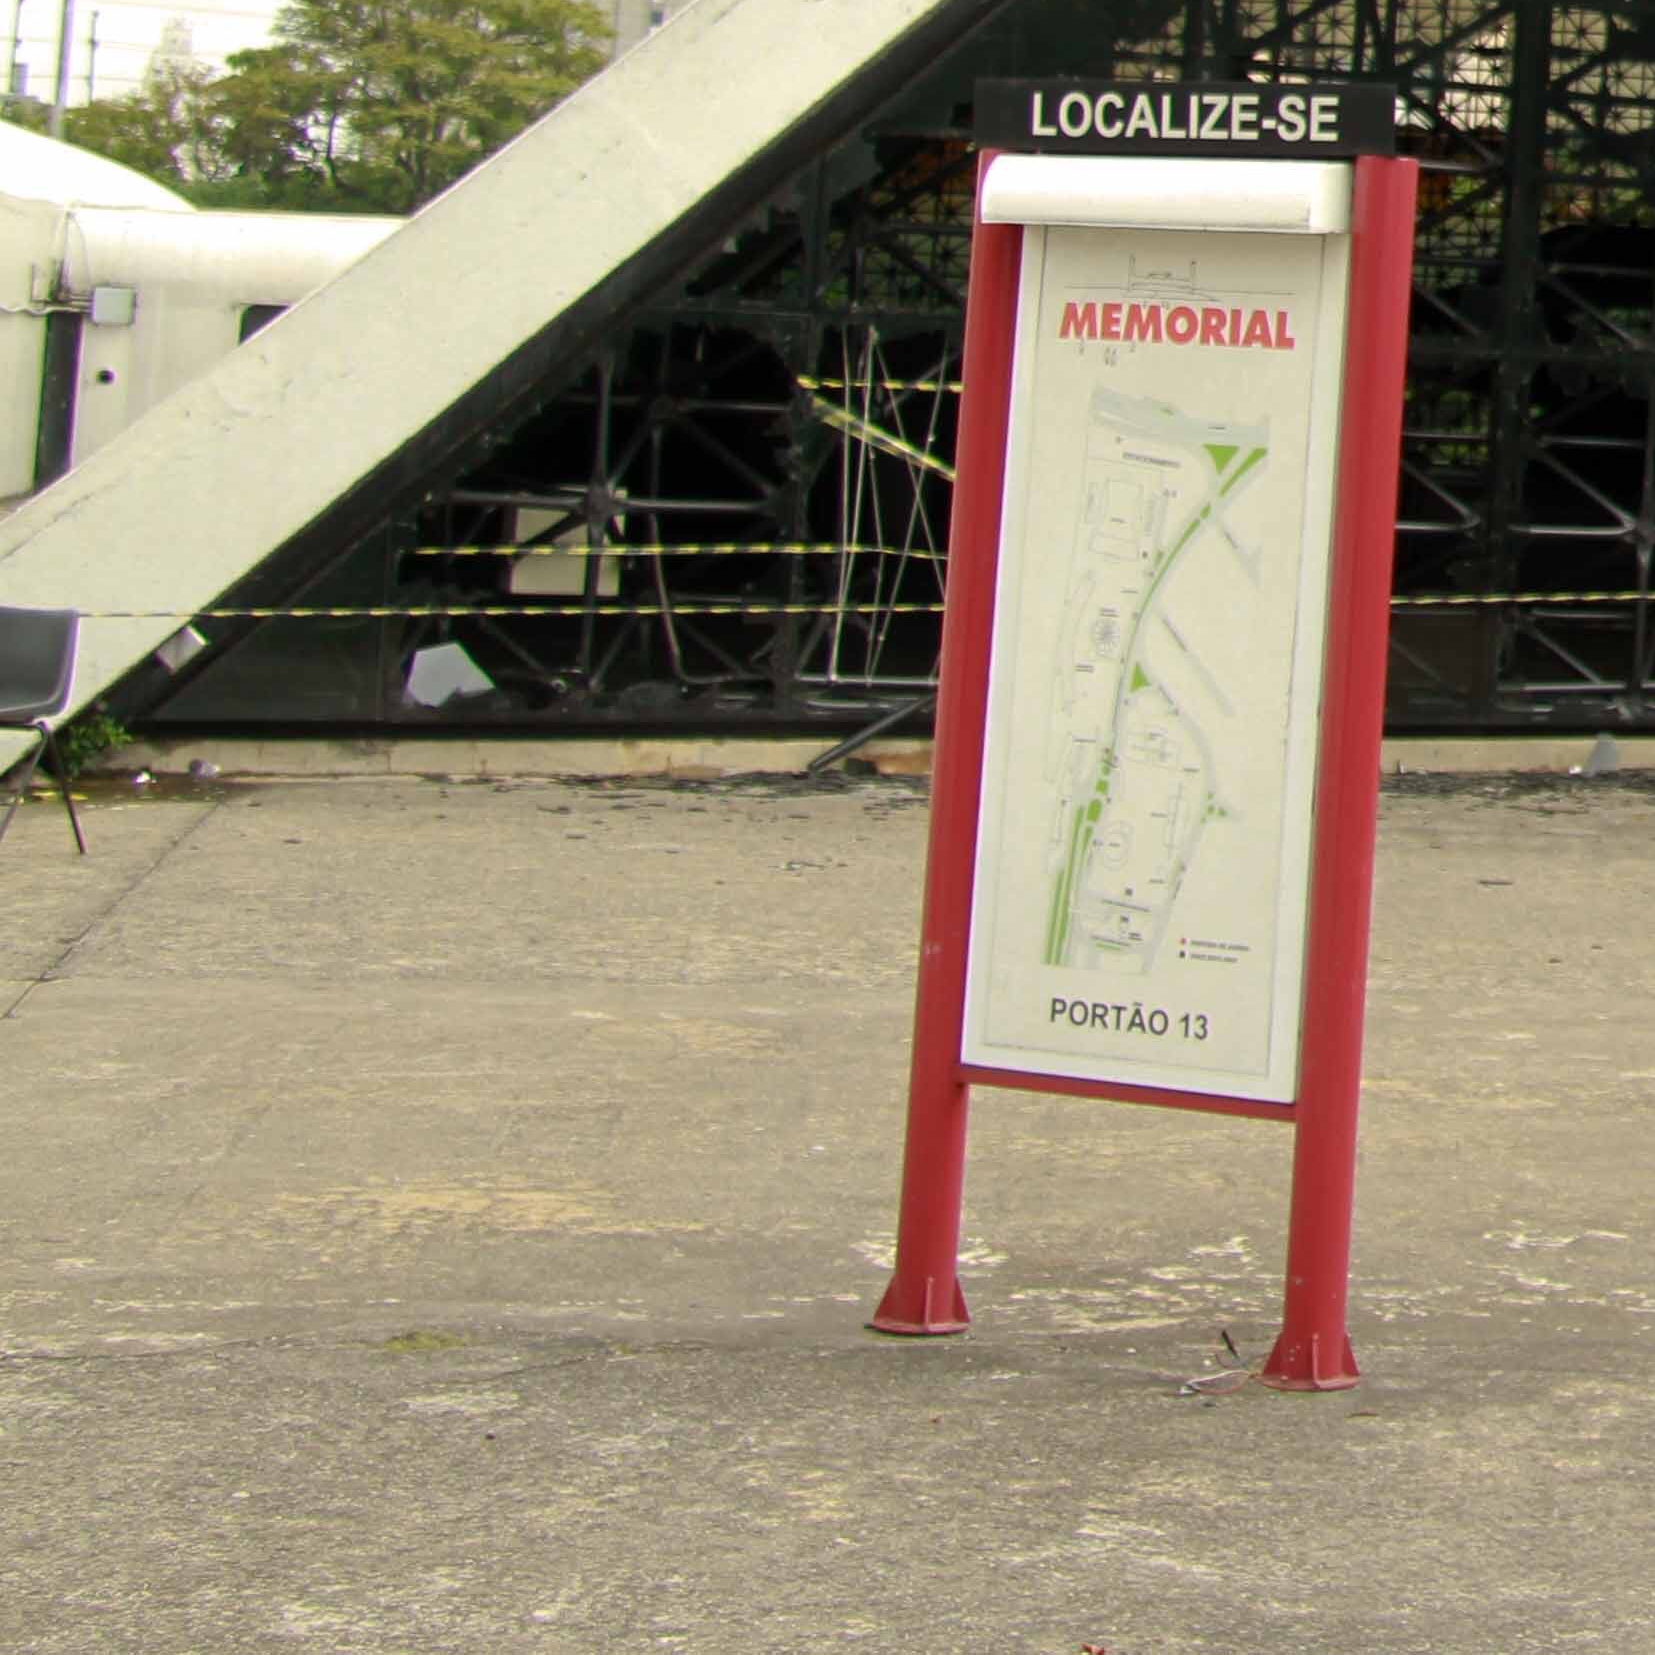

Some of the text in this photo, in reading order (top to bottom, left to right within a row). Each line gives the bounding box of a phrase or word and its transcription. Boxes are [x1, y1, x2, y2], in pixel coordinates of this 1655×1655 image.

[1031, 91, 1340, 143] LOCALIZE-SE
[1059, 301, 1296, 351] MEMORIAL
[1050, 997, 1209, 1041] PORTÃO 13
